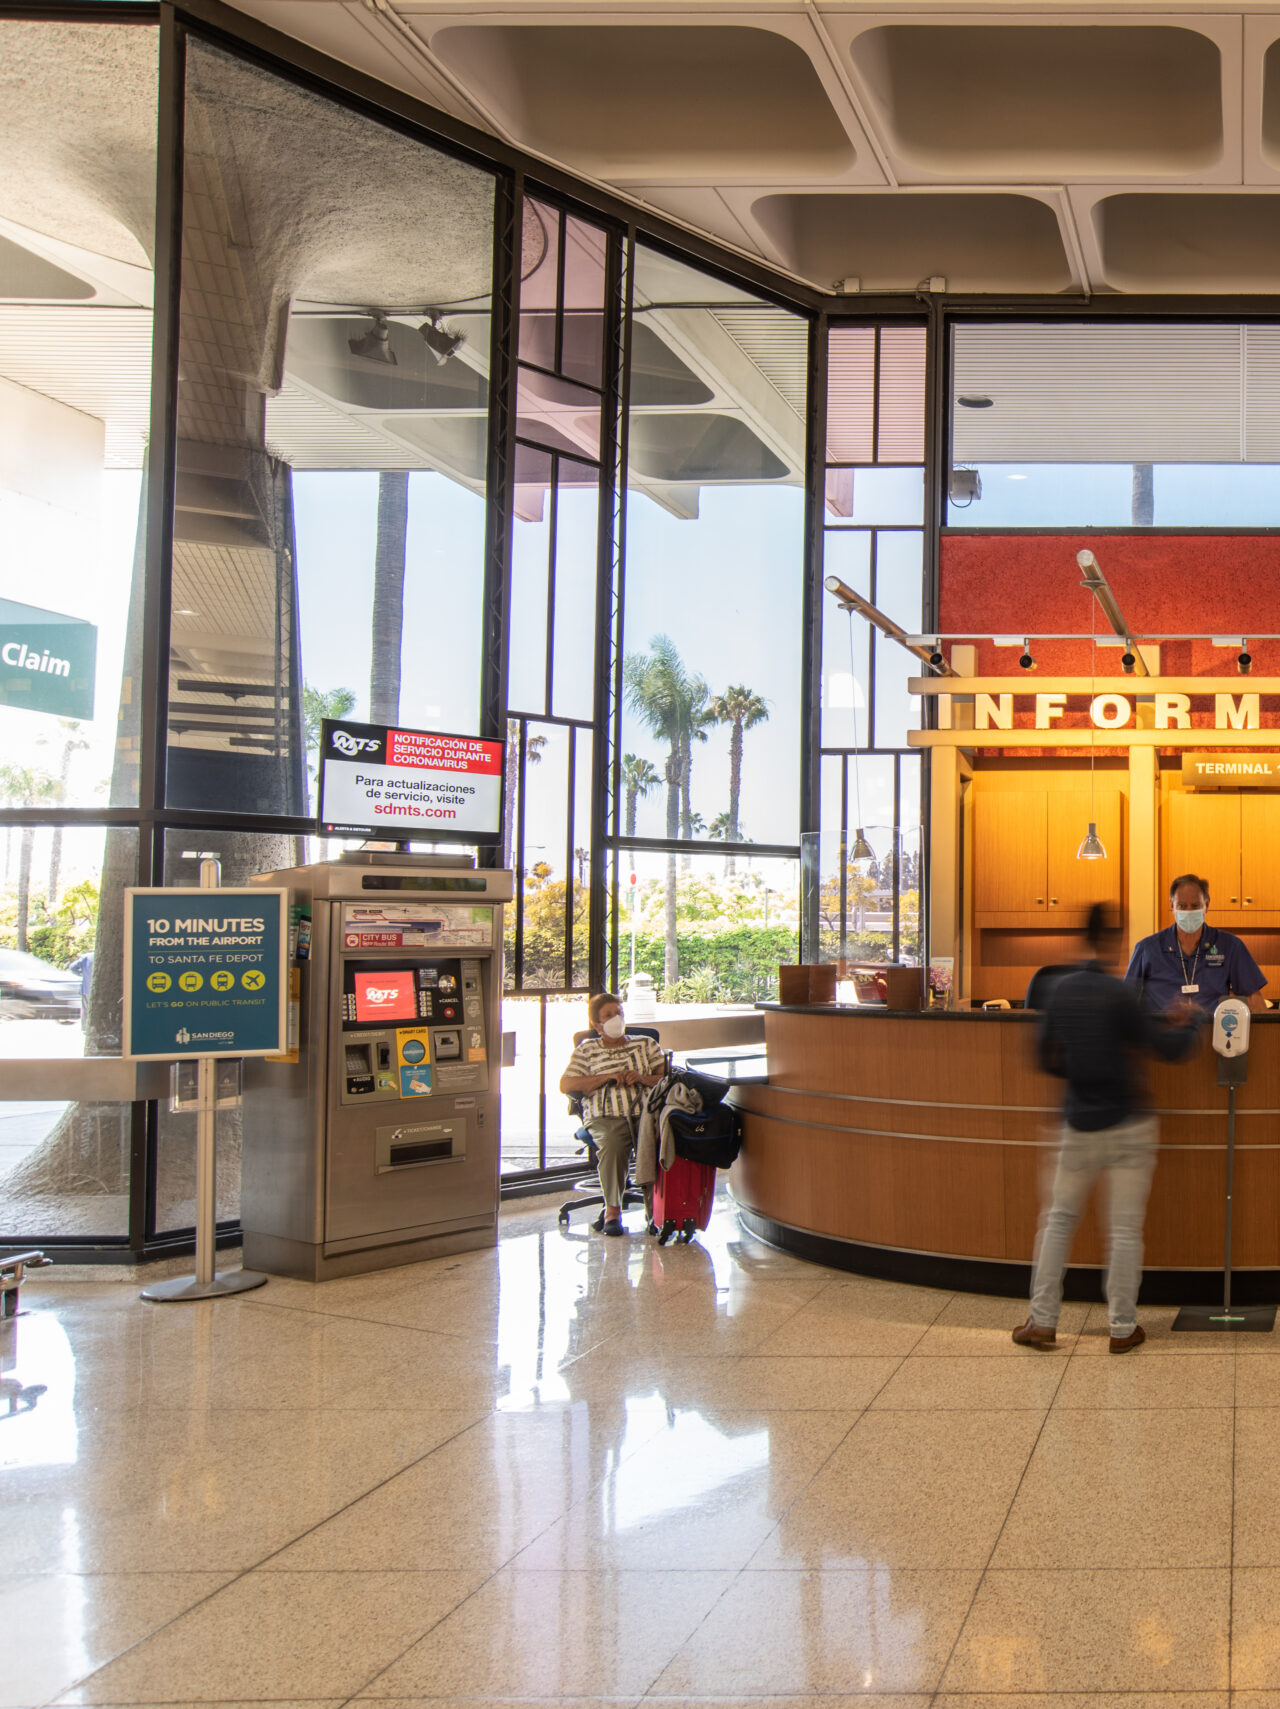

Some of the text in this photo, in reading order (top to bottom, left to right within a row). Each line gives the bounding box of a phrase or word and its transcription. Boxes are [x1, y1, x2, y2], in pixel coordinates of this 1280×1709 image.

[1, 642, 71, 677] Claim
[332, 730, 381, 756] MTS
[394, 733, 483, 752] NOTIFICACIÓN DE
[393, 744, 492, 762] SERVICIO DURANTE
[393, 754, 468, 769] CORONAVIRUS
[1195, 763, 1272, 774] TERMINAL
[355, 775, 476, 794] Para actualizaciones
[366, 788, 466, 804] de servicio, visite
[374, 803, 457, 818] sdmts.com
[146, 918, 265, 933] 10 MINUTES
[149, 936, 263, 946] FROM THE AIRPORT
[148, 954, 263, 964] TO SANTA FE DEPOT
[366, 987, 399, 1003] MTS
